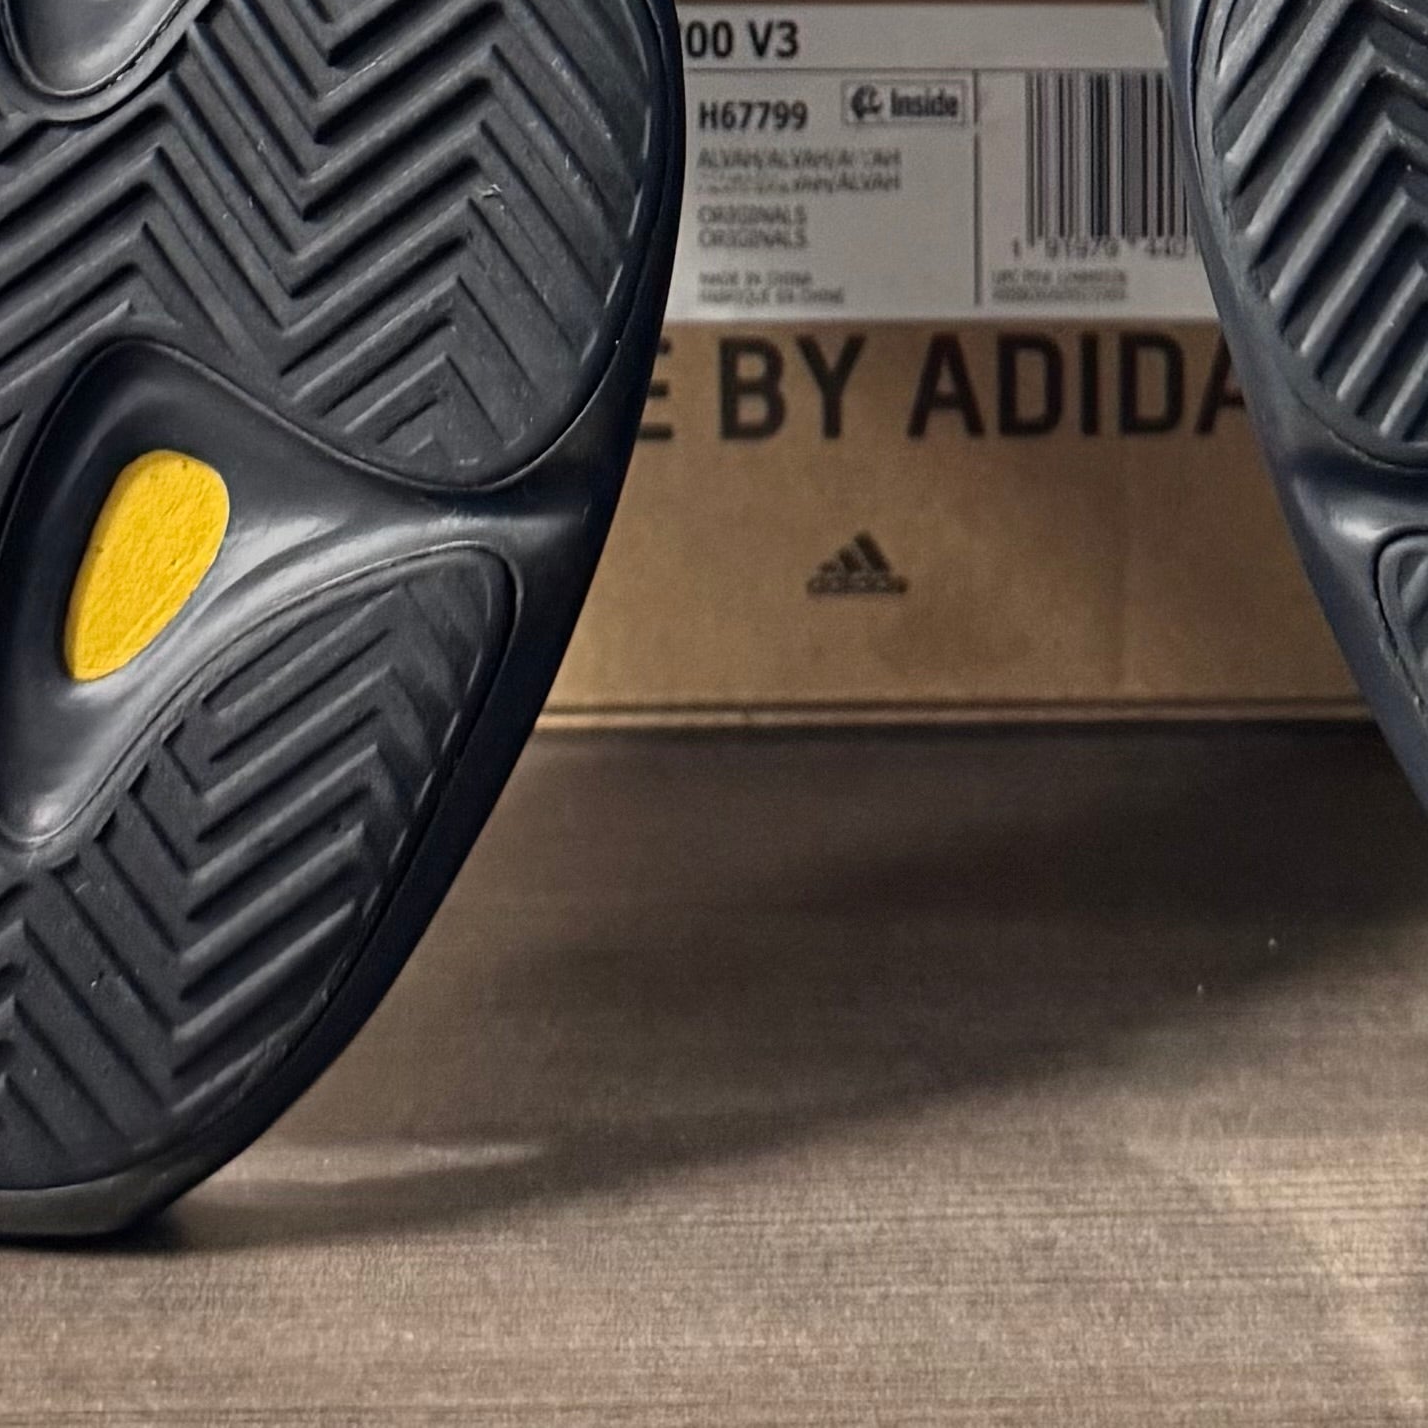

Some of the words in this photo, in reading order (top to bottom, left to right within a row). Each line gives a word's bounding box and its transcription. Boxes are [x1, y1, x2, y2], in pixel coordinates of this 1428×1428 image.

[679, 20, 733, 59] 00
[748, 20, 799, 59] V3
[699, 101, 808, 130] H67799
[890, 87, 959, 118] Inside
[718, 335, 866, 440] BY
